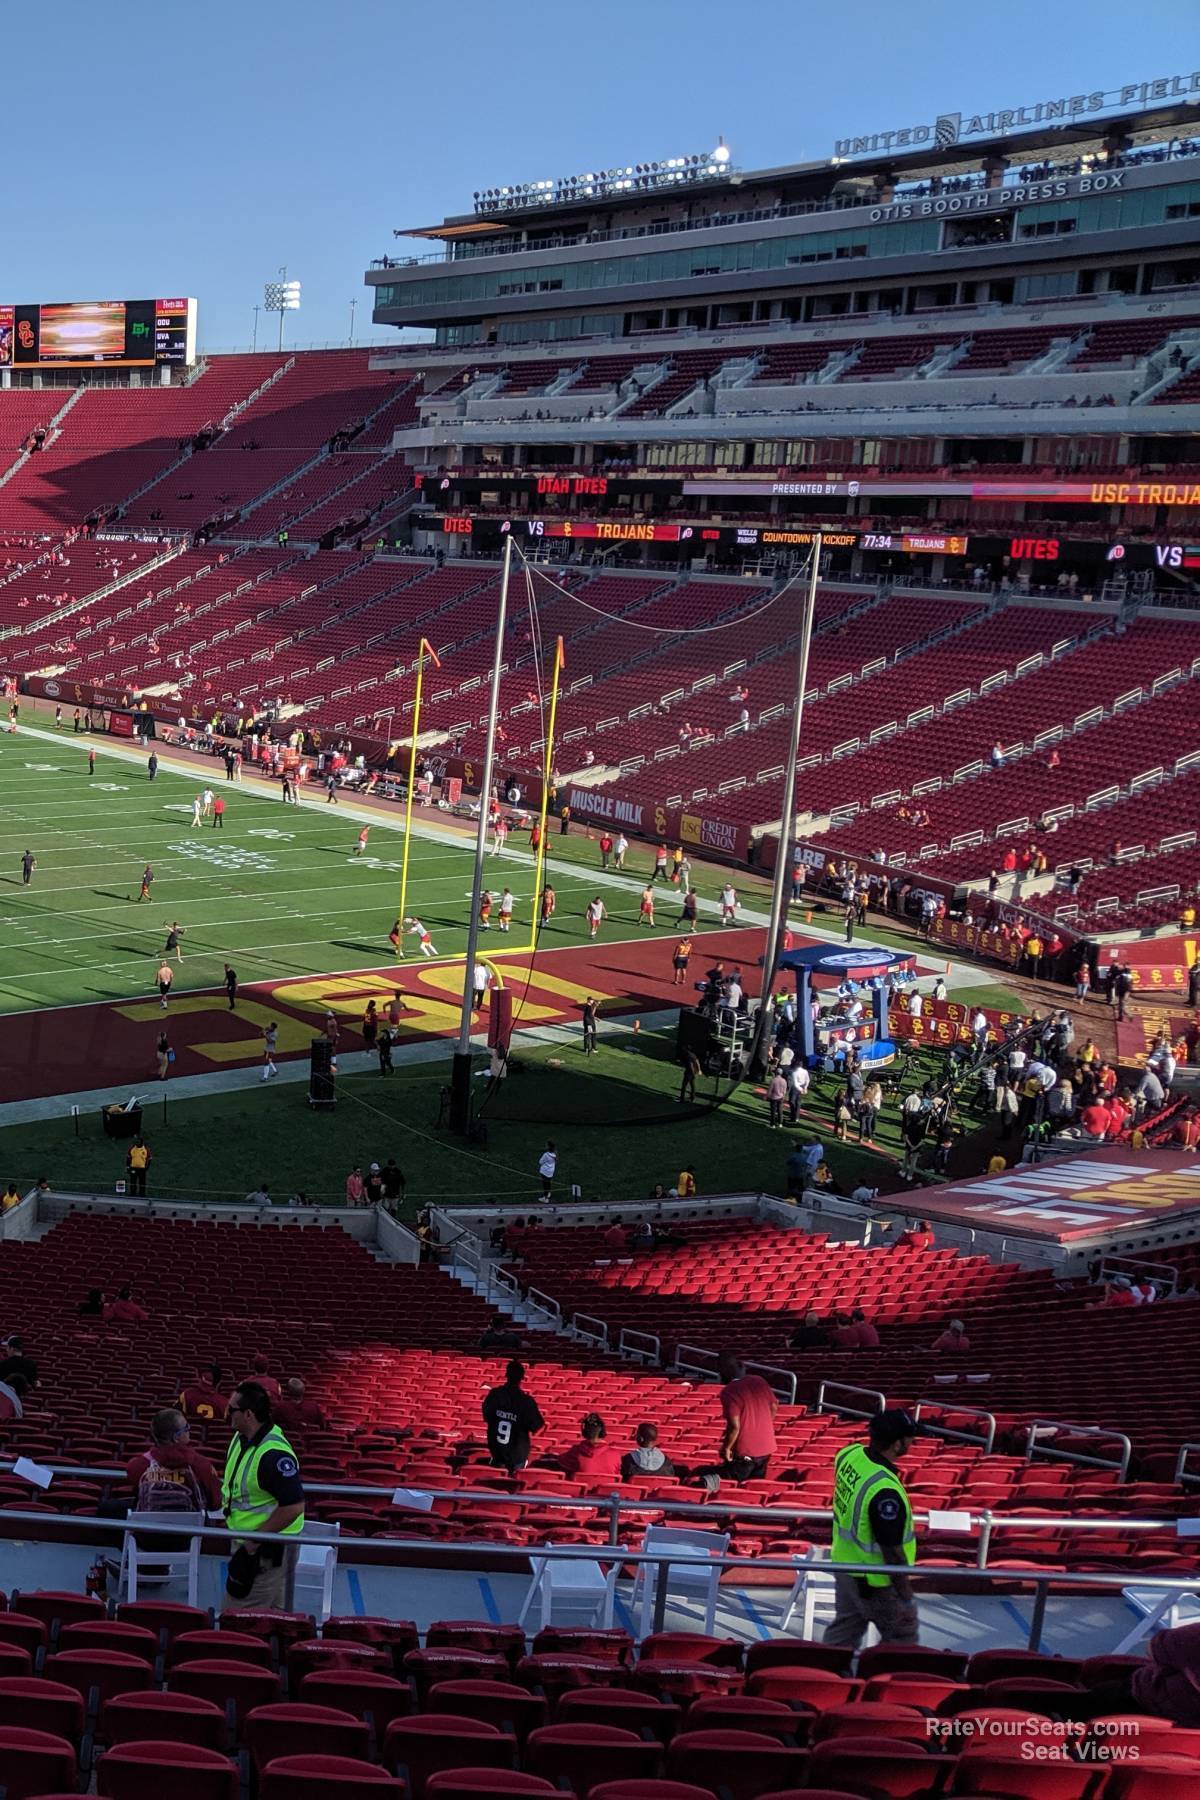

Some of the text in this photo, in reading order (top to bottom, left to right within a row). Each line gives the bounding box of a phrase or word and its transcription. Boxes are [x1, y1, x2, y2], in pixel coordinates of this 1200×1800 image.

[835, 125, 929, 157] UNITED
[967, 92, 1104, 134] AIRLINES
[870, 172, 1127, 223] OTIS BOOTH PRESS BOX
[537, 477, 608, 495] UTAH UTES
[772, 483, 837, 495] PRESENTED BY
[1091, 483, 1130, 503] USC
[443, 516, 473, 534] UTES
[528, 520, 544, 536] VS
[596, 523, 655, 540] TROJANS
[737, 528, 758, 537] WELLS
[762, 532, 810, 544] COUNTDOWN
[823, 534, 856, 546] KICKOFF
[864, 534, 892, 549] 77:34
[909, 538, 945, 550] TROJANS
[1010, 538, 1060, 561] UTES
[1156, 545, 1183, 568] VS
[569, 788, 645, 826] MUSCLE MILK
[682, 818, 740, 840] USC CREDIT
[701, 830, 737, 851] UNION
[110, 964, 643, 1062] USC
[943, 1159, 1162, 1203] MILK
[496, 1420, 512, 1445] 9
[840, 1461, 861, 1489] APEX
